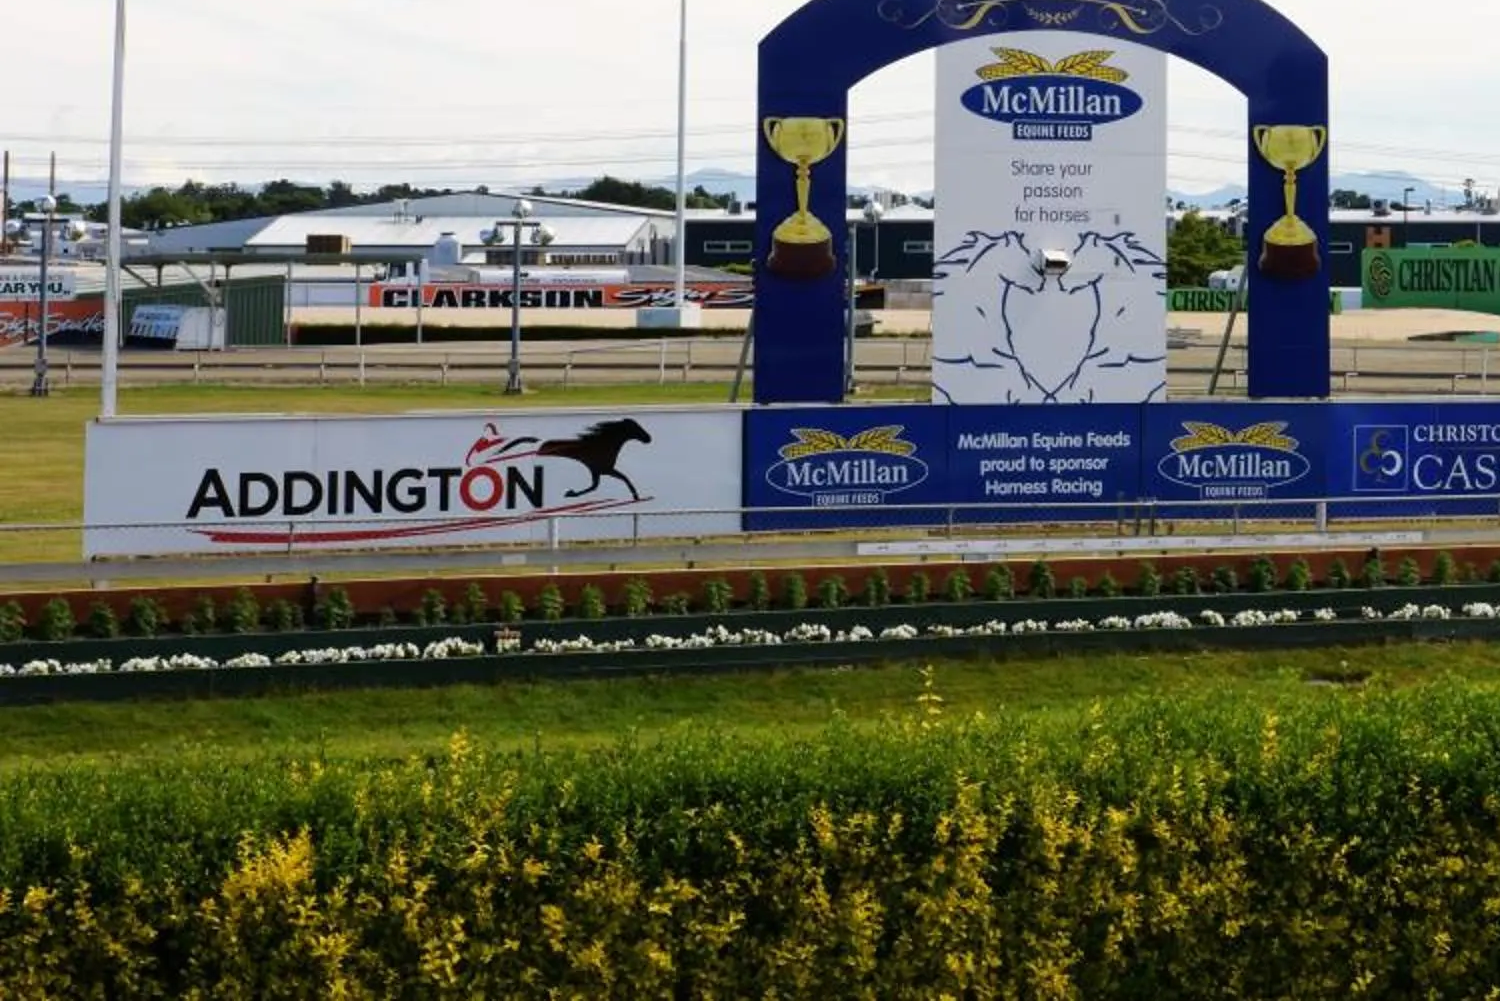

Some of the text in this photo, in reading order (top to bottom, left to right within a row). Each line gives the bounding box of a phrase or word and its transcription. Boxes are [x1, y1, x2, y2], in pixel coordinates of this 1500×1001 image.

[982, 85, 1122, 116] McMillan
[1016, 124, 1089, 139] EQUINE FEEDS
[1011, 160, 1093, 179] Share your
[1023, 184, 1083, 200] passion
[1014, 205, 1091, 223] for horses
[1400, 258, 1496, 293] CHRISTIAN
[381, 287, 604, 307] CLARKSON
[958, 431, 1131, 451] McMillan Equine Feeds
[786, 459, 909, 487] McMillan
[979, 456, 1109, 476] proud to sponsor
[1178, 453, 1291, 479] McMillan
[186, 465, 545, 519] ADDINGTON
[985, 479, 1103, 497] Harness Racing
[1204, 486, 1263, 497] EQUINE FEEDS
[816, 493, 880, 505] EQUINE FEEDS
